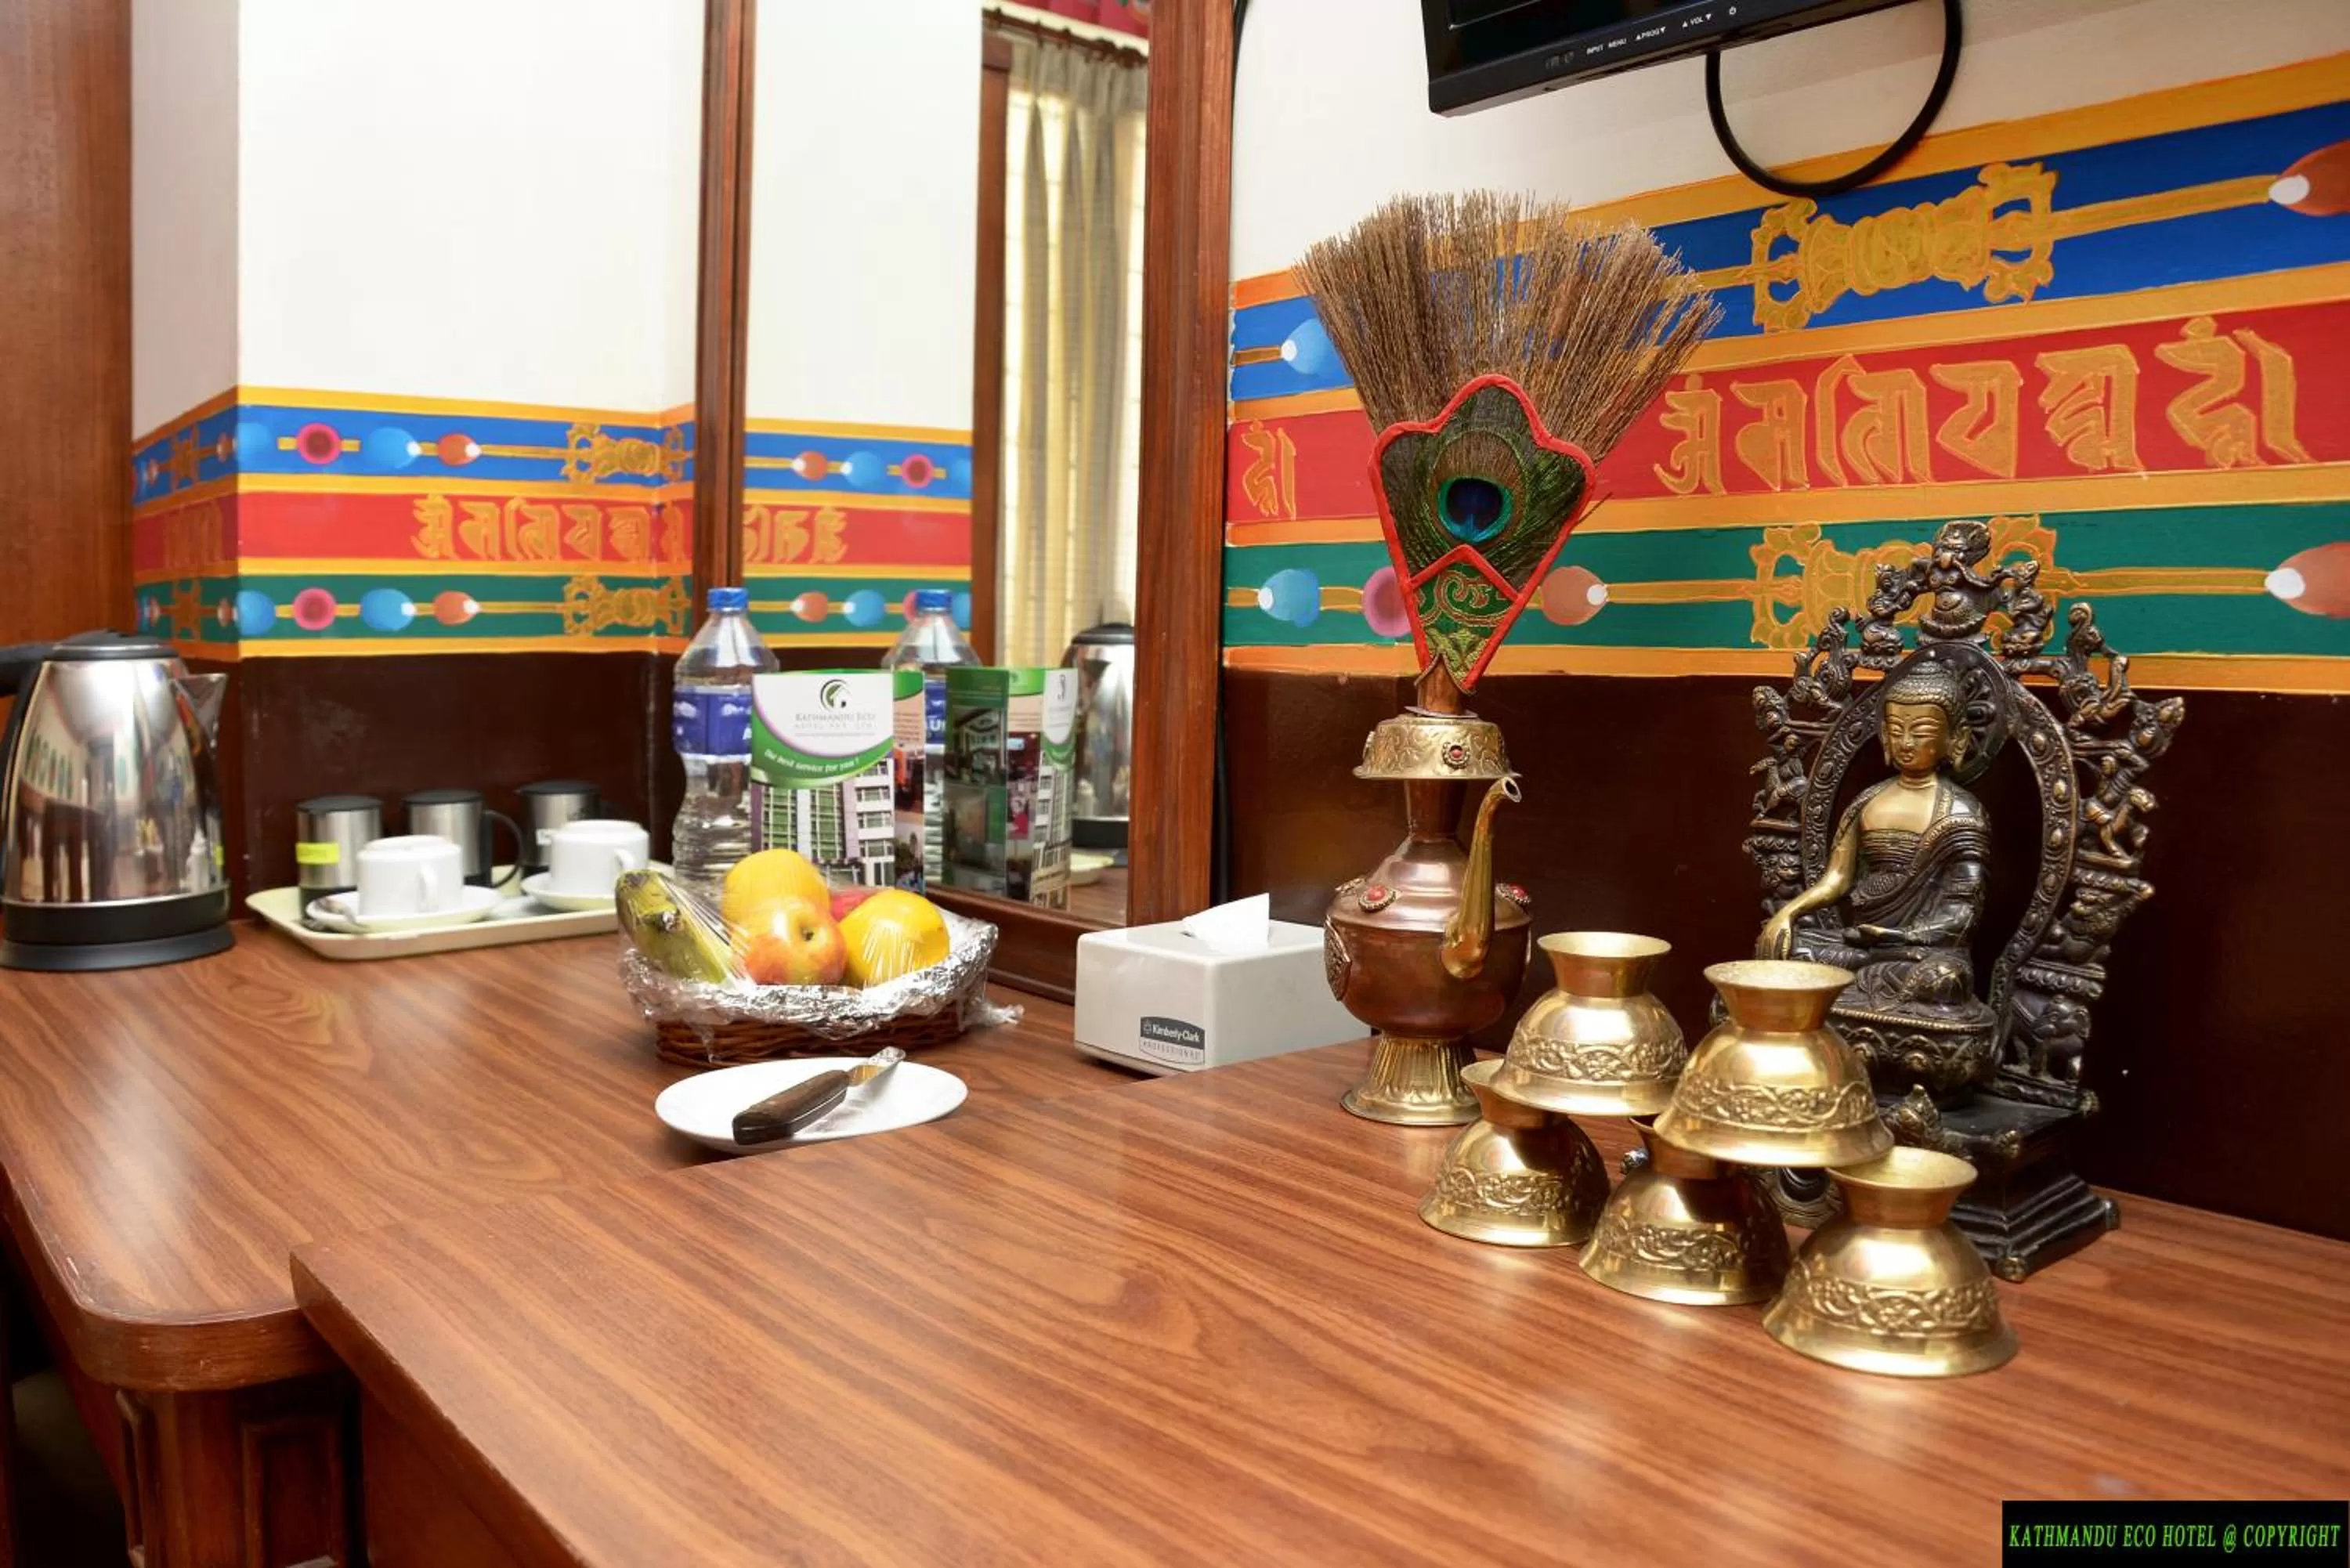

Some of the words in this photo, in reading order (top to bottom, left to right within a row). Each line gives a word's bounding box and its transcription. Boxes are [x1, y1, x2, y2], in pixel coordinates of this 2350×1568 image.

[1690, 16, 1704, 26] VOL
[1586, 44, 1604, 55] INPUT
[1608, 38, 1627, 49] MENU
